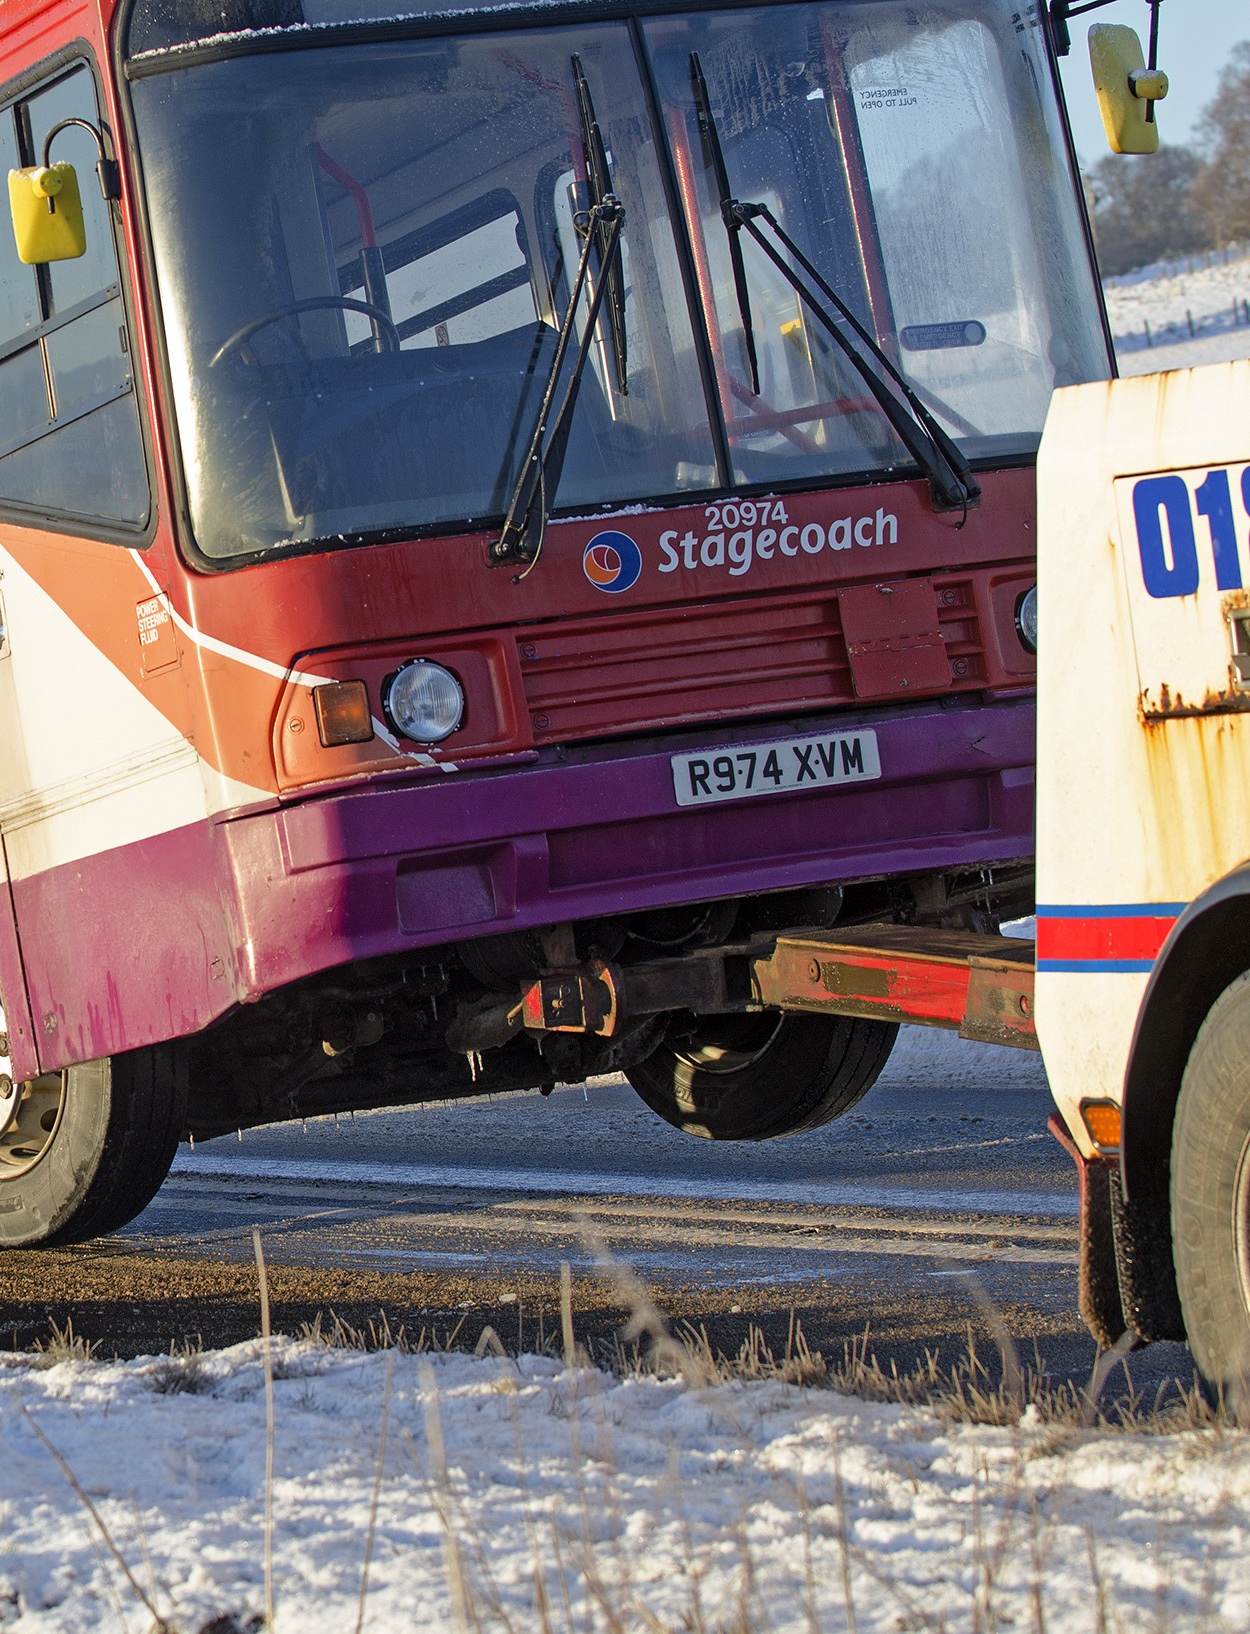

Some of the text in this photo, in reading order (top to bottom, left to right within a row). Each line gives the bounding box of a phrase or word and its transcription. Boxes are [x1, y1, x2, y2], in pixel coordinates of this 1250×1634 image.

[950, 324, 963, 332] EXIT
[704, 501, 788, 531] 20974
[658, 507, 898, 576] Stagecoach
[1132, 465, 1250, 599] 01
[136, 599, 159, 619] POWER
[138, 609, 168, 632] STEERING
[140, 628, 159, 646] FLUID
[688, 738, 864, 797] R974 XVM
